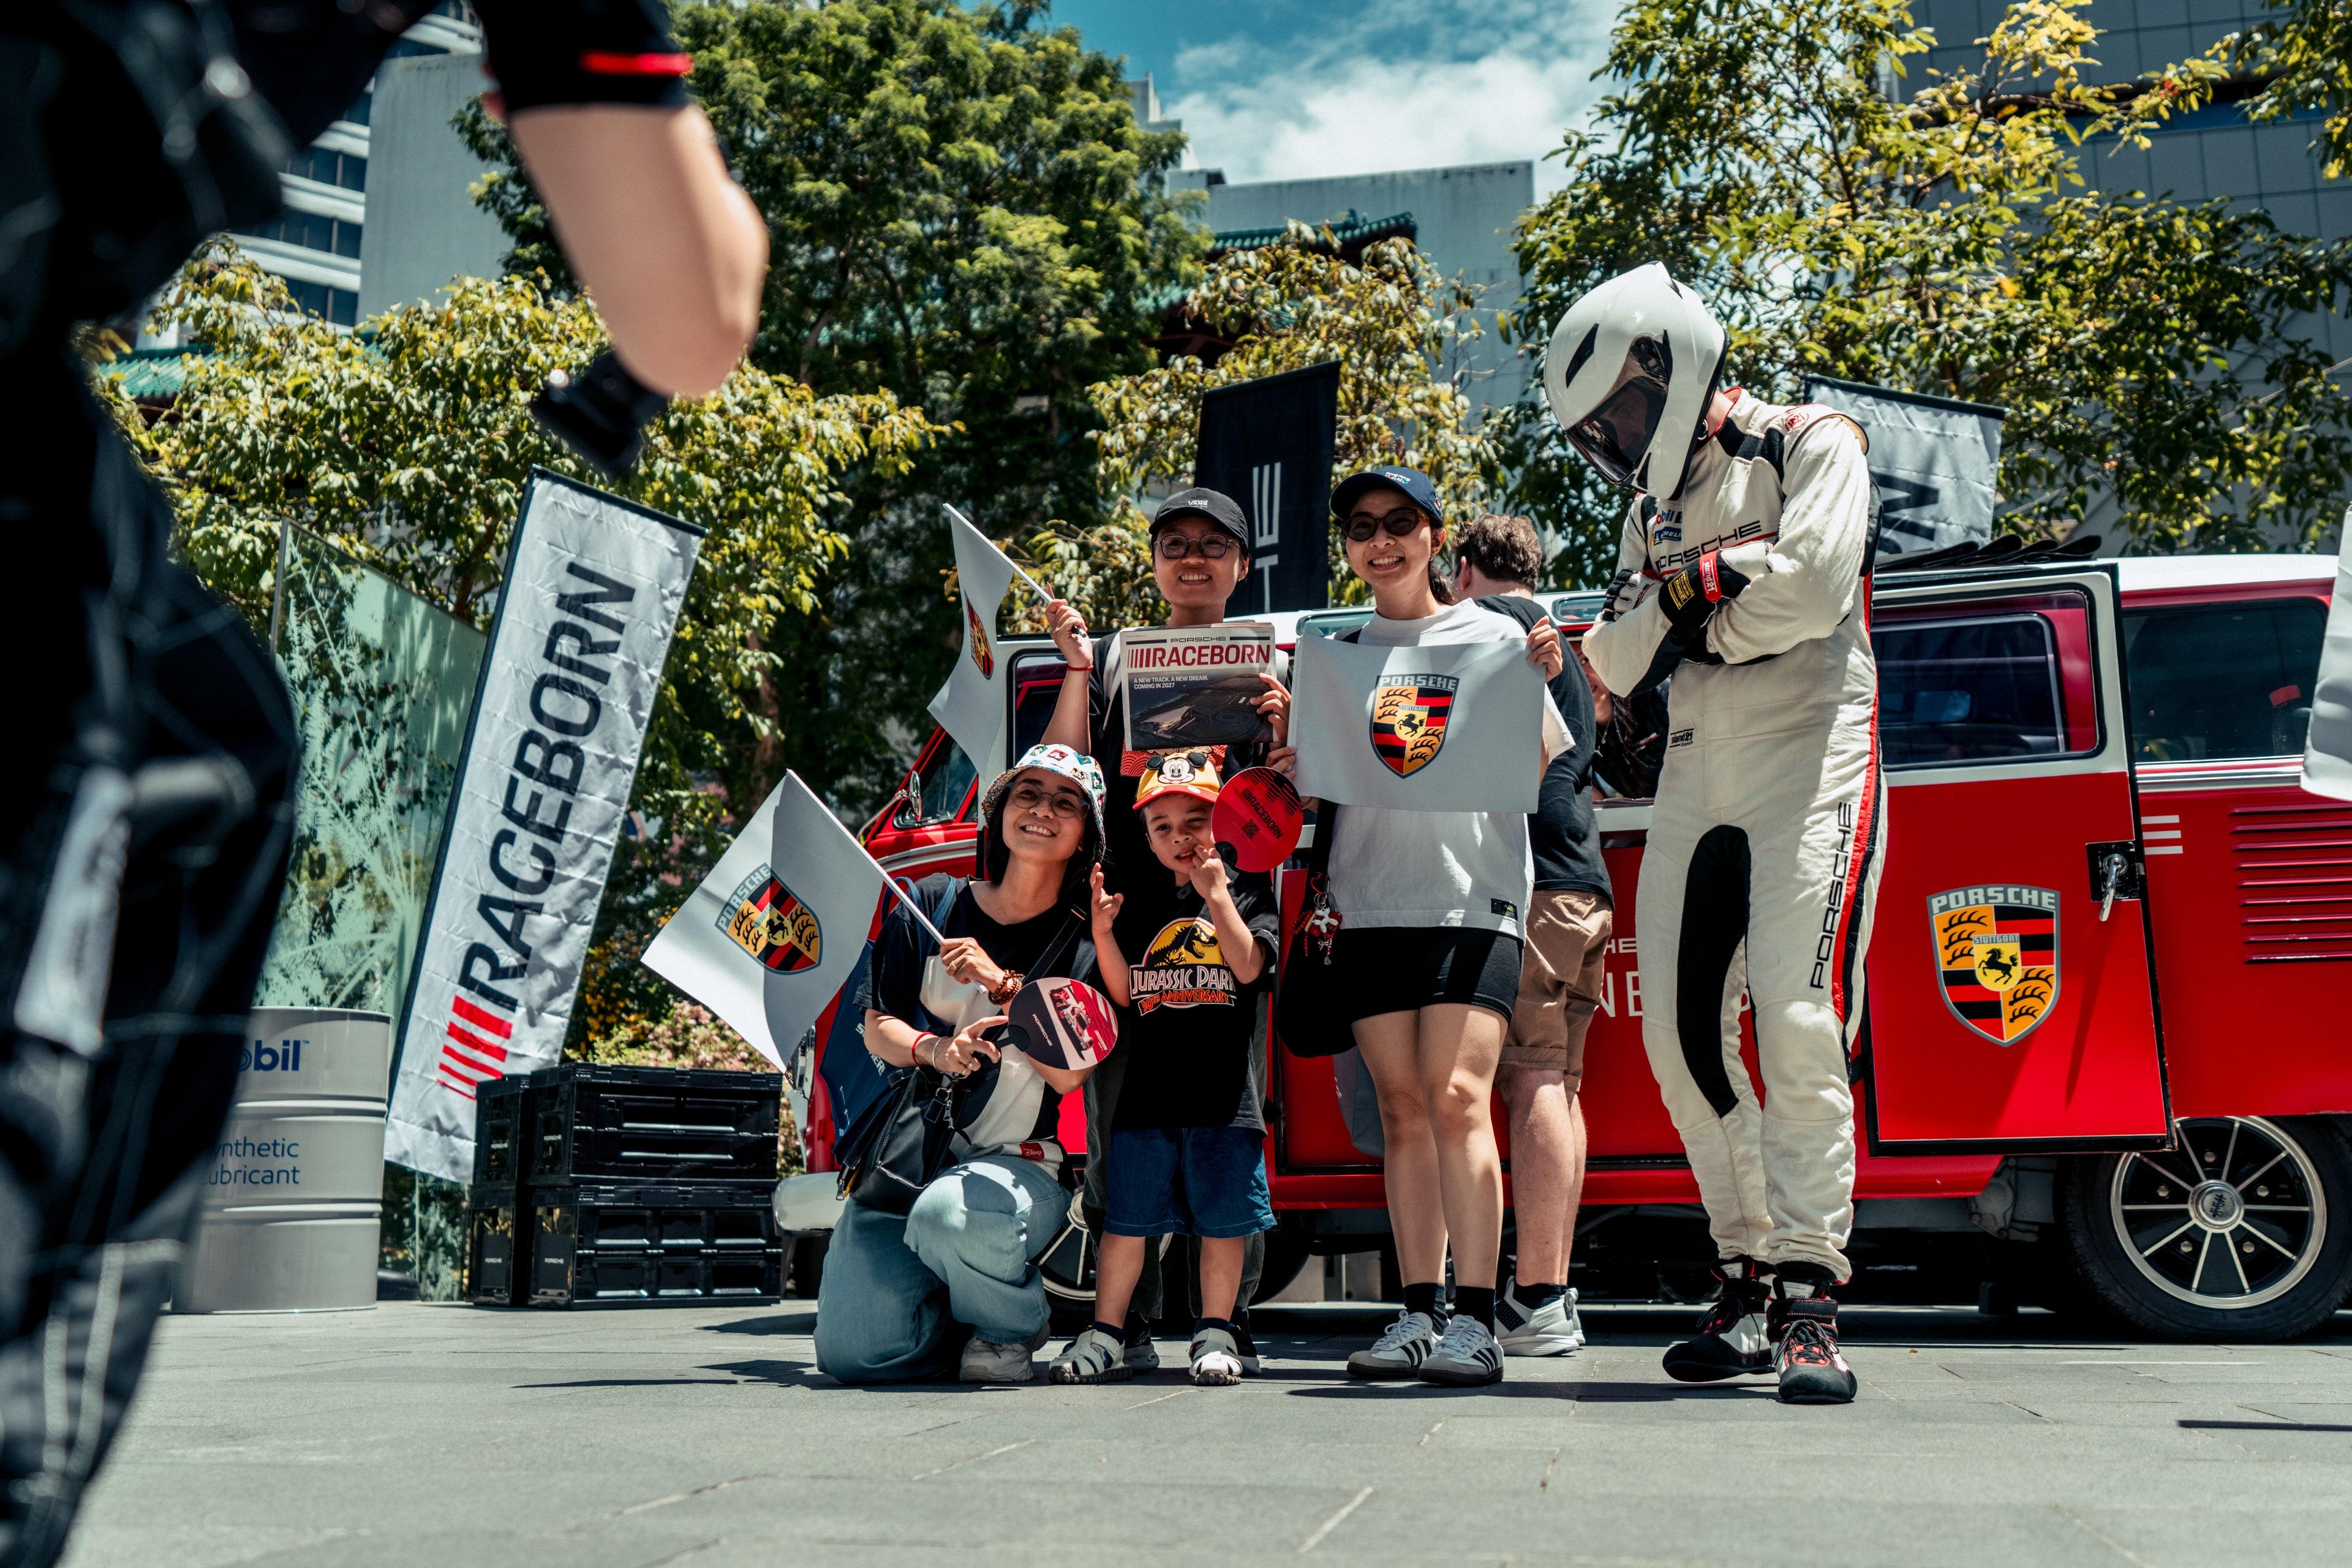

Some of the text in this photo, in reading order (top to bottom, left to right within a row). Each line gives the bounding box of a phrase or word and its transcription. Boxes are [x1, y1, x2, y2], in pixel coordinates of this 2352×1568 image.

[1152, 644, 1270, 667] RACEBORN
[1379, 676, 1457, 690] PORSCHE
[459, 560, 636, 1012] RACEBORN
[1248, 796, 1284, 839] RACEBORN
[717, 865, 772, 931] PORSCHE
[1809, 802, 1851, 989] PORSCHE
[1931, 887, 2056, 914] PORSCHE
[1973, 935, 2019, 943] STUTTGART
[1133, 968, 1193, 994] JURASSIC
[1141, 989, 1229, 1012] 30TH ANNIVERSARY
[1032, 1014, 1053, 1047] PORSCHE
[213, 1136, 300, 1163] ynthetic
[209, 1165, 300, 1185] ubricant
